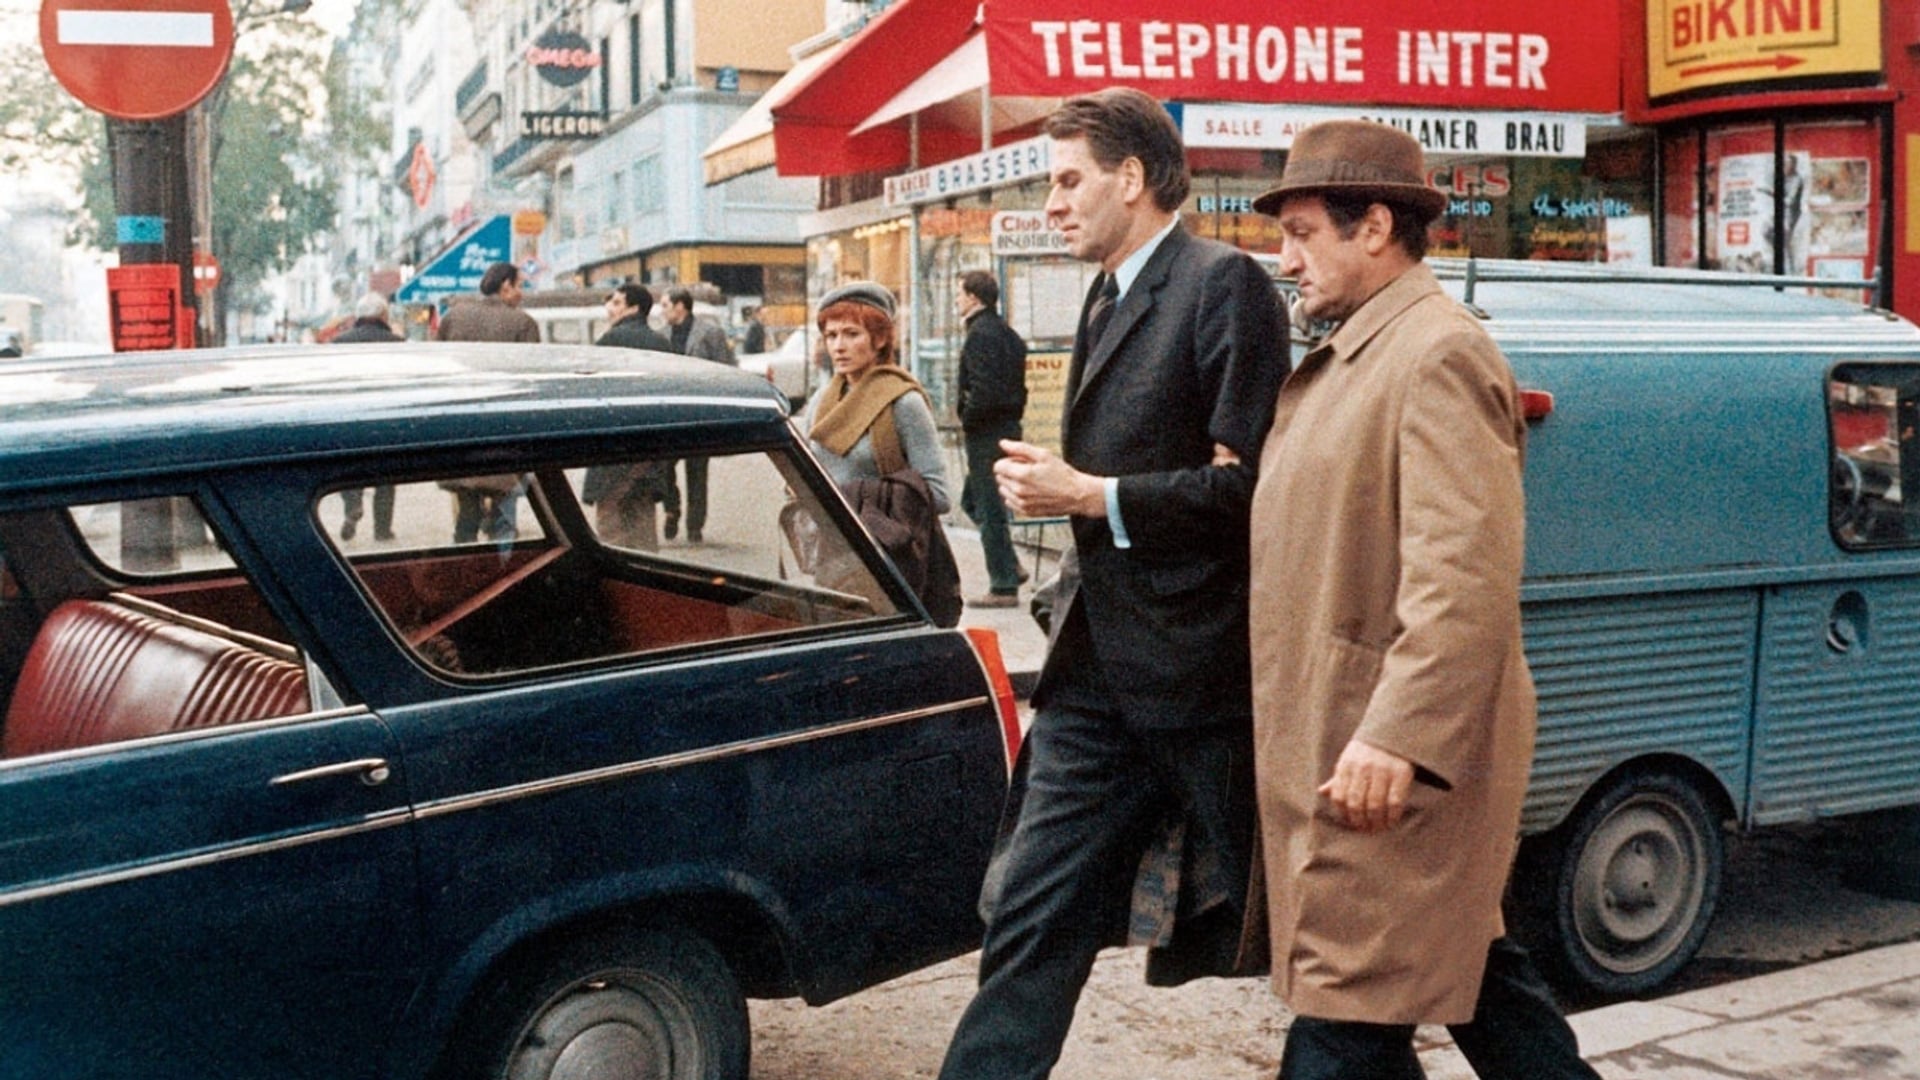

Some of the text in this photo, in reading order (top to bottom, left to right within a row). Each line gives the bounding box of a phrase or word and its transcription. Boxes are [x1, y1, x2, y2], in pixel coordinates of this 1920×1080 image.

[1672, 0, 1822, 48] BIKINI
[526, 47, 603, 68] OMEGA
[1398, 30, 1550, 91] INTER
[521, 115, 603, 136] LIGERON
[1205, 119, 1263, 136] SALLE
[1505, 121, 1565, 152] BRAU
[937, 142, 1049, 193] BRASSERI
[1424, 166, 1511, 197] CES
[1199, 196, 1254, 214] BUFFE
[1442, 200, 1492, 216] HAUD
[1000, 215, 1042, 232] Club
[1023, 360, 1063, 371] ENU
